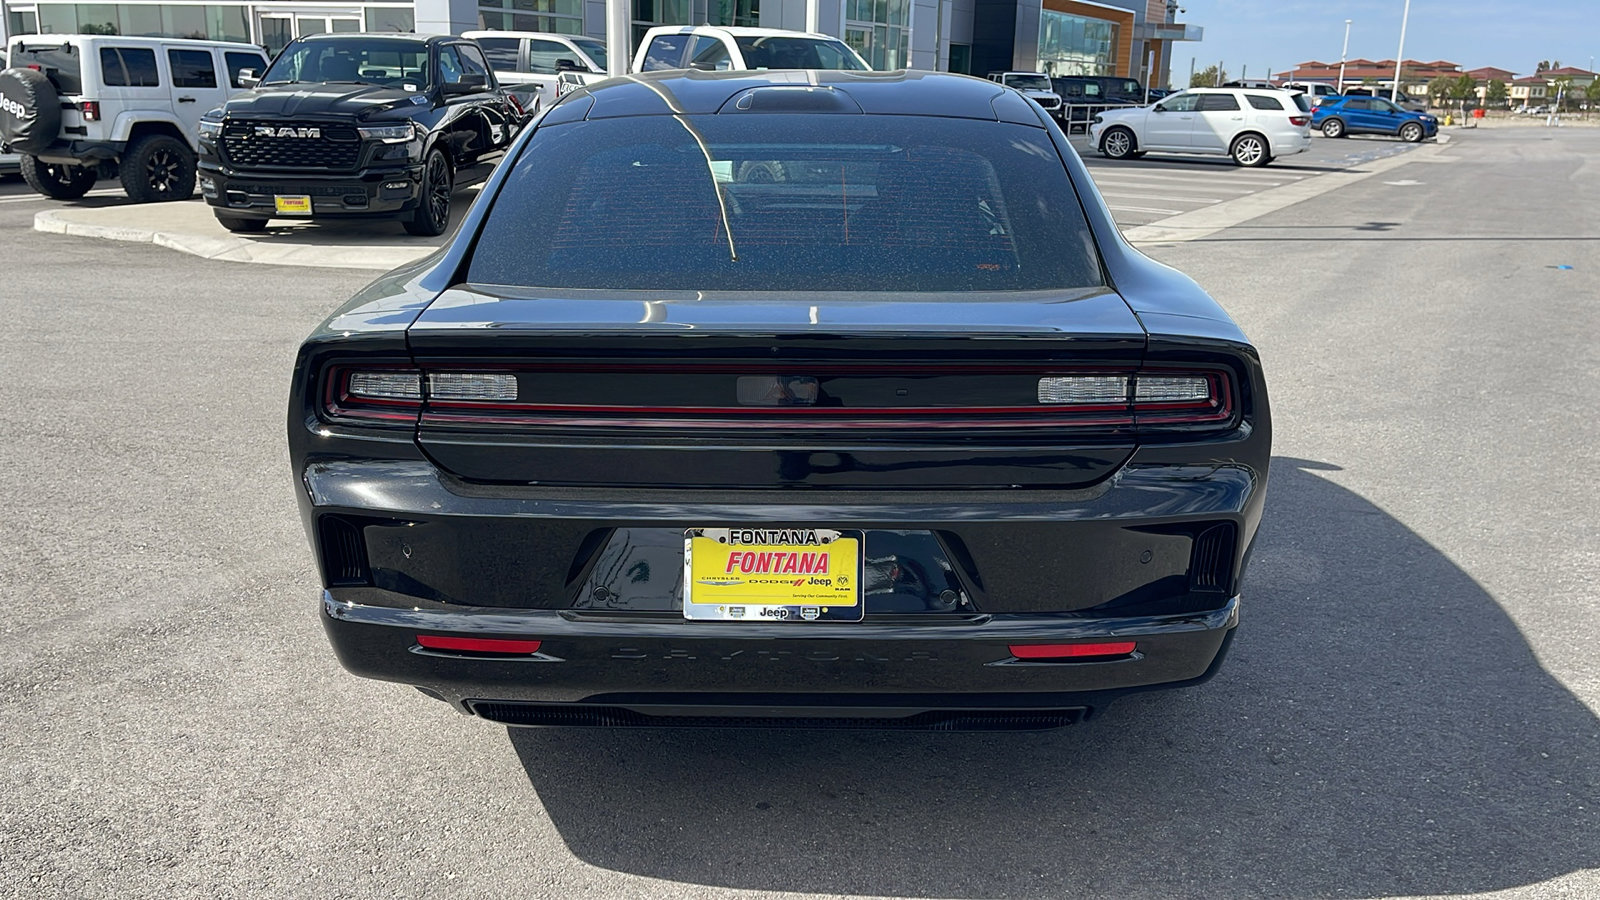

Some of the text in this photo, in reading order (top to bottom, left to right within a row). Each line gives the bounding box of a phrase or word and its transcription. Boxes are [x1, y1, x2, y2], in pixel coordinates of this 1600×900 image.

[0, 92, 25, 119] Jeep
[254, 127, 320, 138] RAM
[730, 529, 818, 545] FONTANA
[726, 551, 828, 574] FONTANA
[808, 577, 832, 587] Jeep
[760, 608, 787, 618] Jeep
